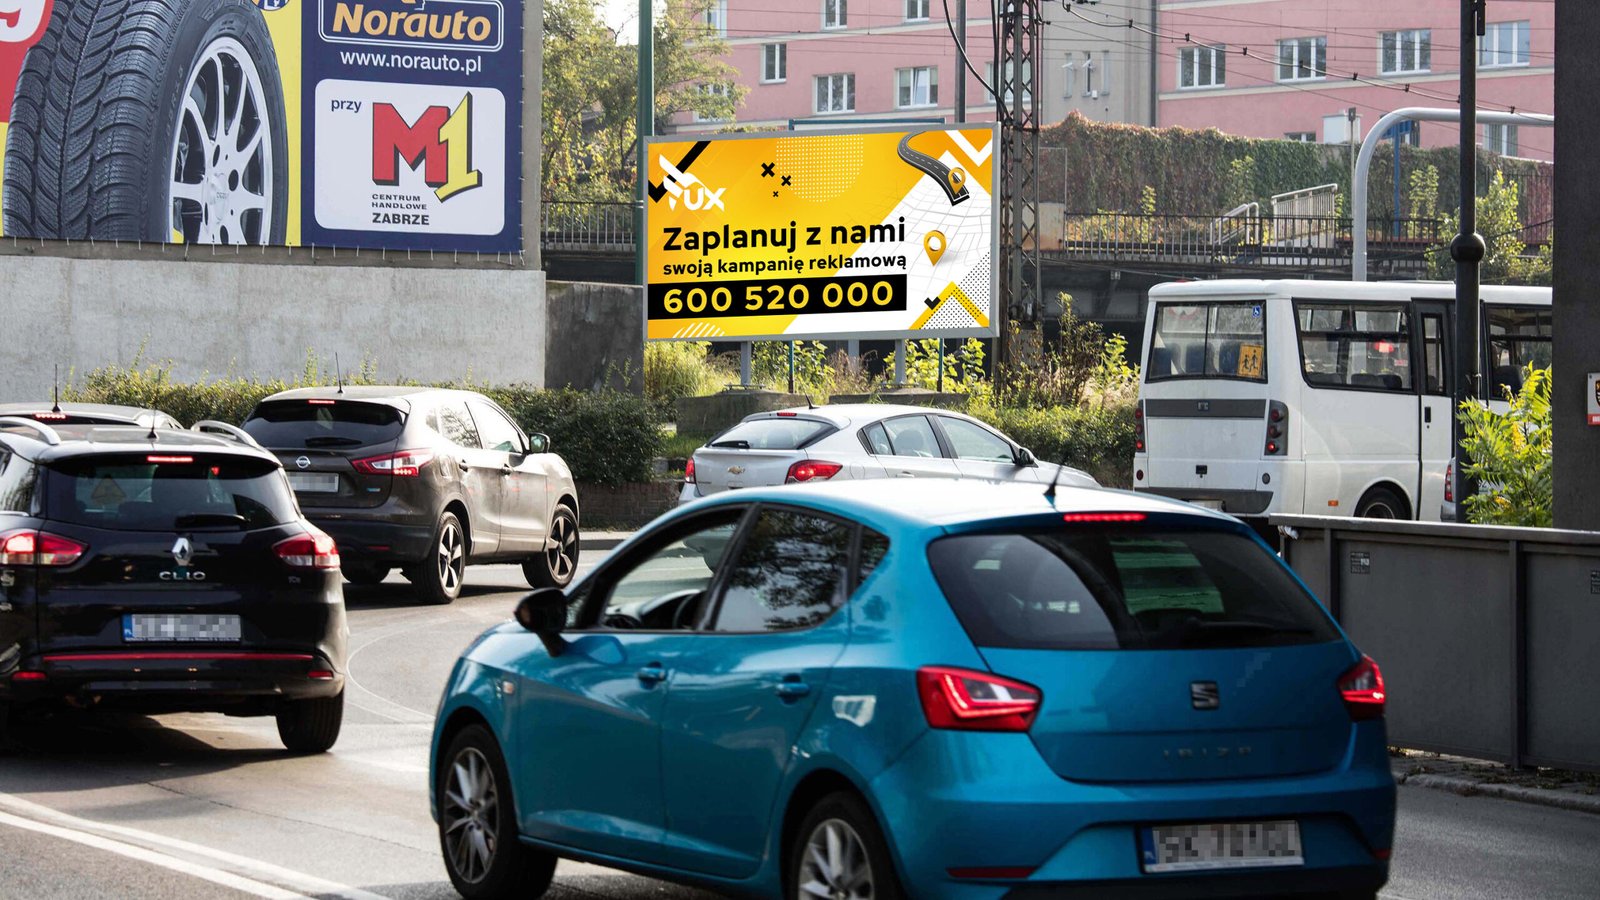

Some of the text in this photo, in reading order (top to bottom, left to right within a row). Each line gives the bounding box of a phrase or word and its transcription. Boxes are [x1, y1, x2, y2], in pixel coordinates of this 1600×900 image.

[332, 2, 491, 42] Norauto
[340, 51, 482, 75] www.norauto.pl
[331, 98, 362, 113] przy
[372, 91, 483, 203] M1
[371, 193, 421, 202] CENTRUM
[371, 202, 427, 210] HANDLOWE
[372, 212, 430, 226] ZABRZE
[663, 216, 905, 255] Zaplanuj z nami
[663, 253, 907, 277] swoją kampanię reklamową
[663, 280, 894, 314] 600 520 000
[159, 571, 206, 581] CLIO
